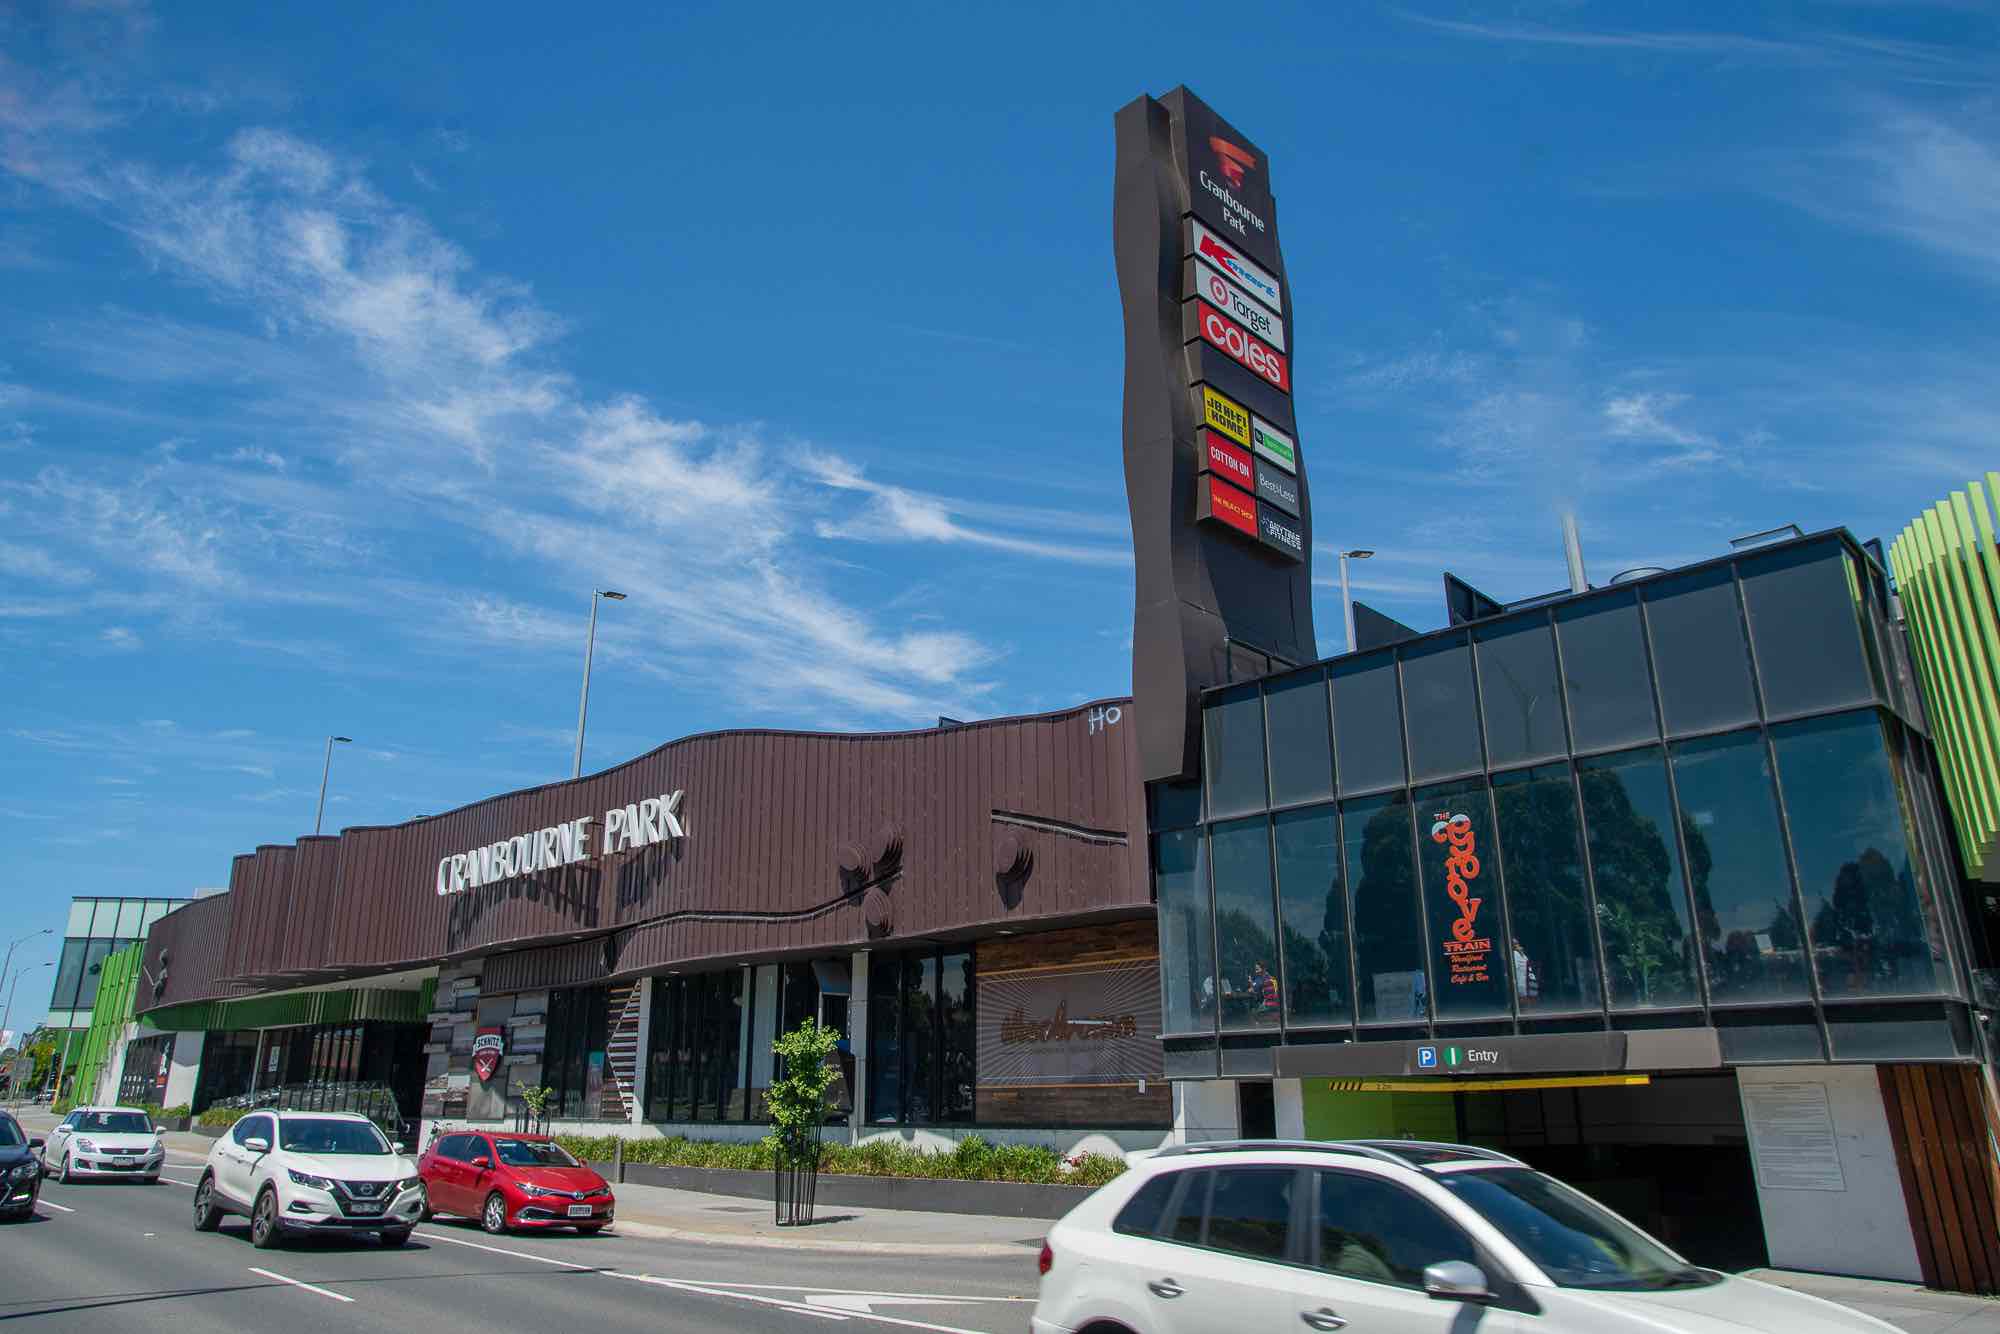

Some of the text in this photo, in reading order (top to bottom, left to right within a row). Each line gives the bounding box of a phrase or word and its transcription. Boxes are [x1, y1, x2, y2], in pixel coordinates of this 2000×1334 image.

[1200, 169, 1264, 232] Cranbourne
[1223, 207, 1247, 236] Park
[1229, 290, 1271, 335] Target
[1206, 314, 1280, 383] coles
[1207, 398, 1221, 413] JB
[1211, 410, 1244, 437] HOME
[1210, 446, 1249, 478] COTTON ON
[1433, 812, 1450, 821] THE
[437, 789, 685, 896] CRANBOURNE PARK
[1443, 940, 1491, 953] TRAIN
[1467, 1050, 1498, 1064] Entry
